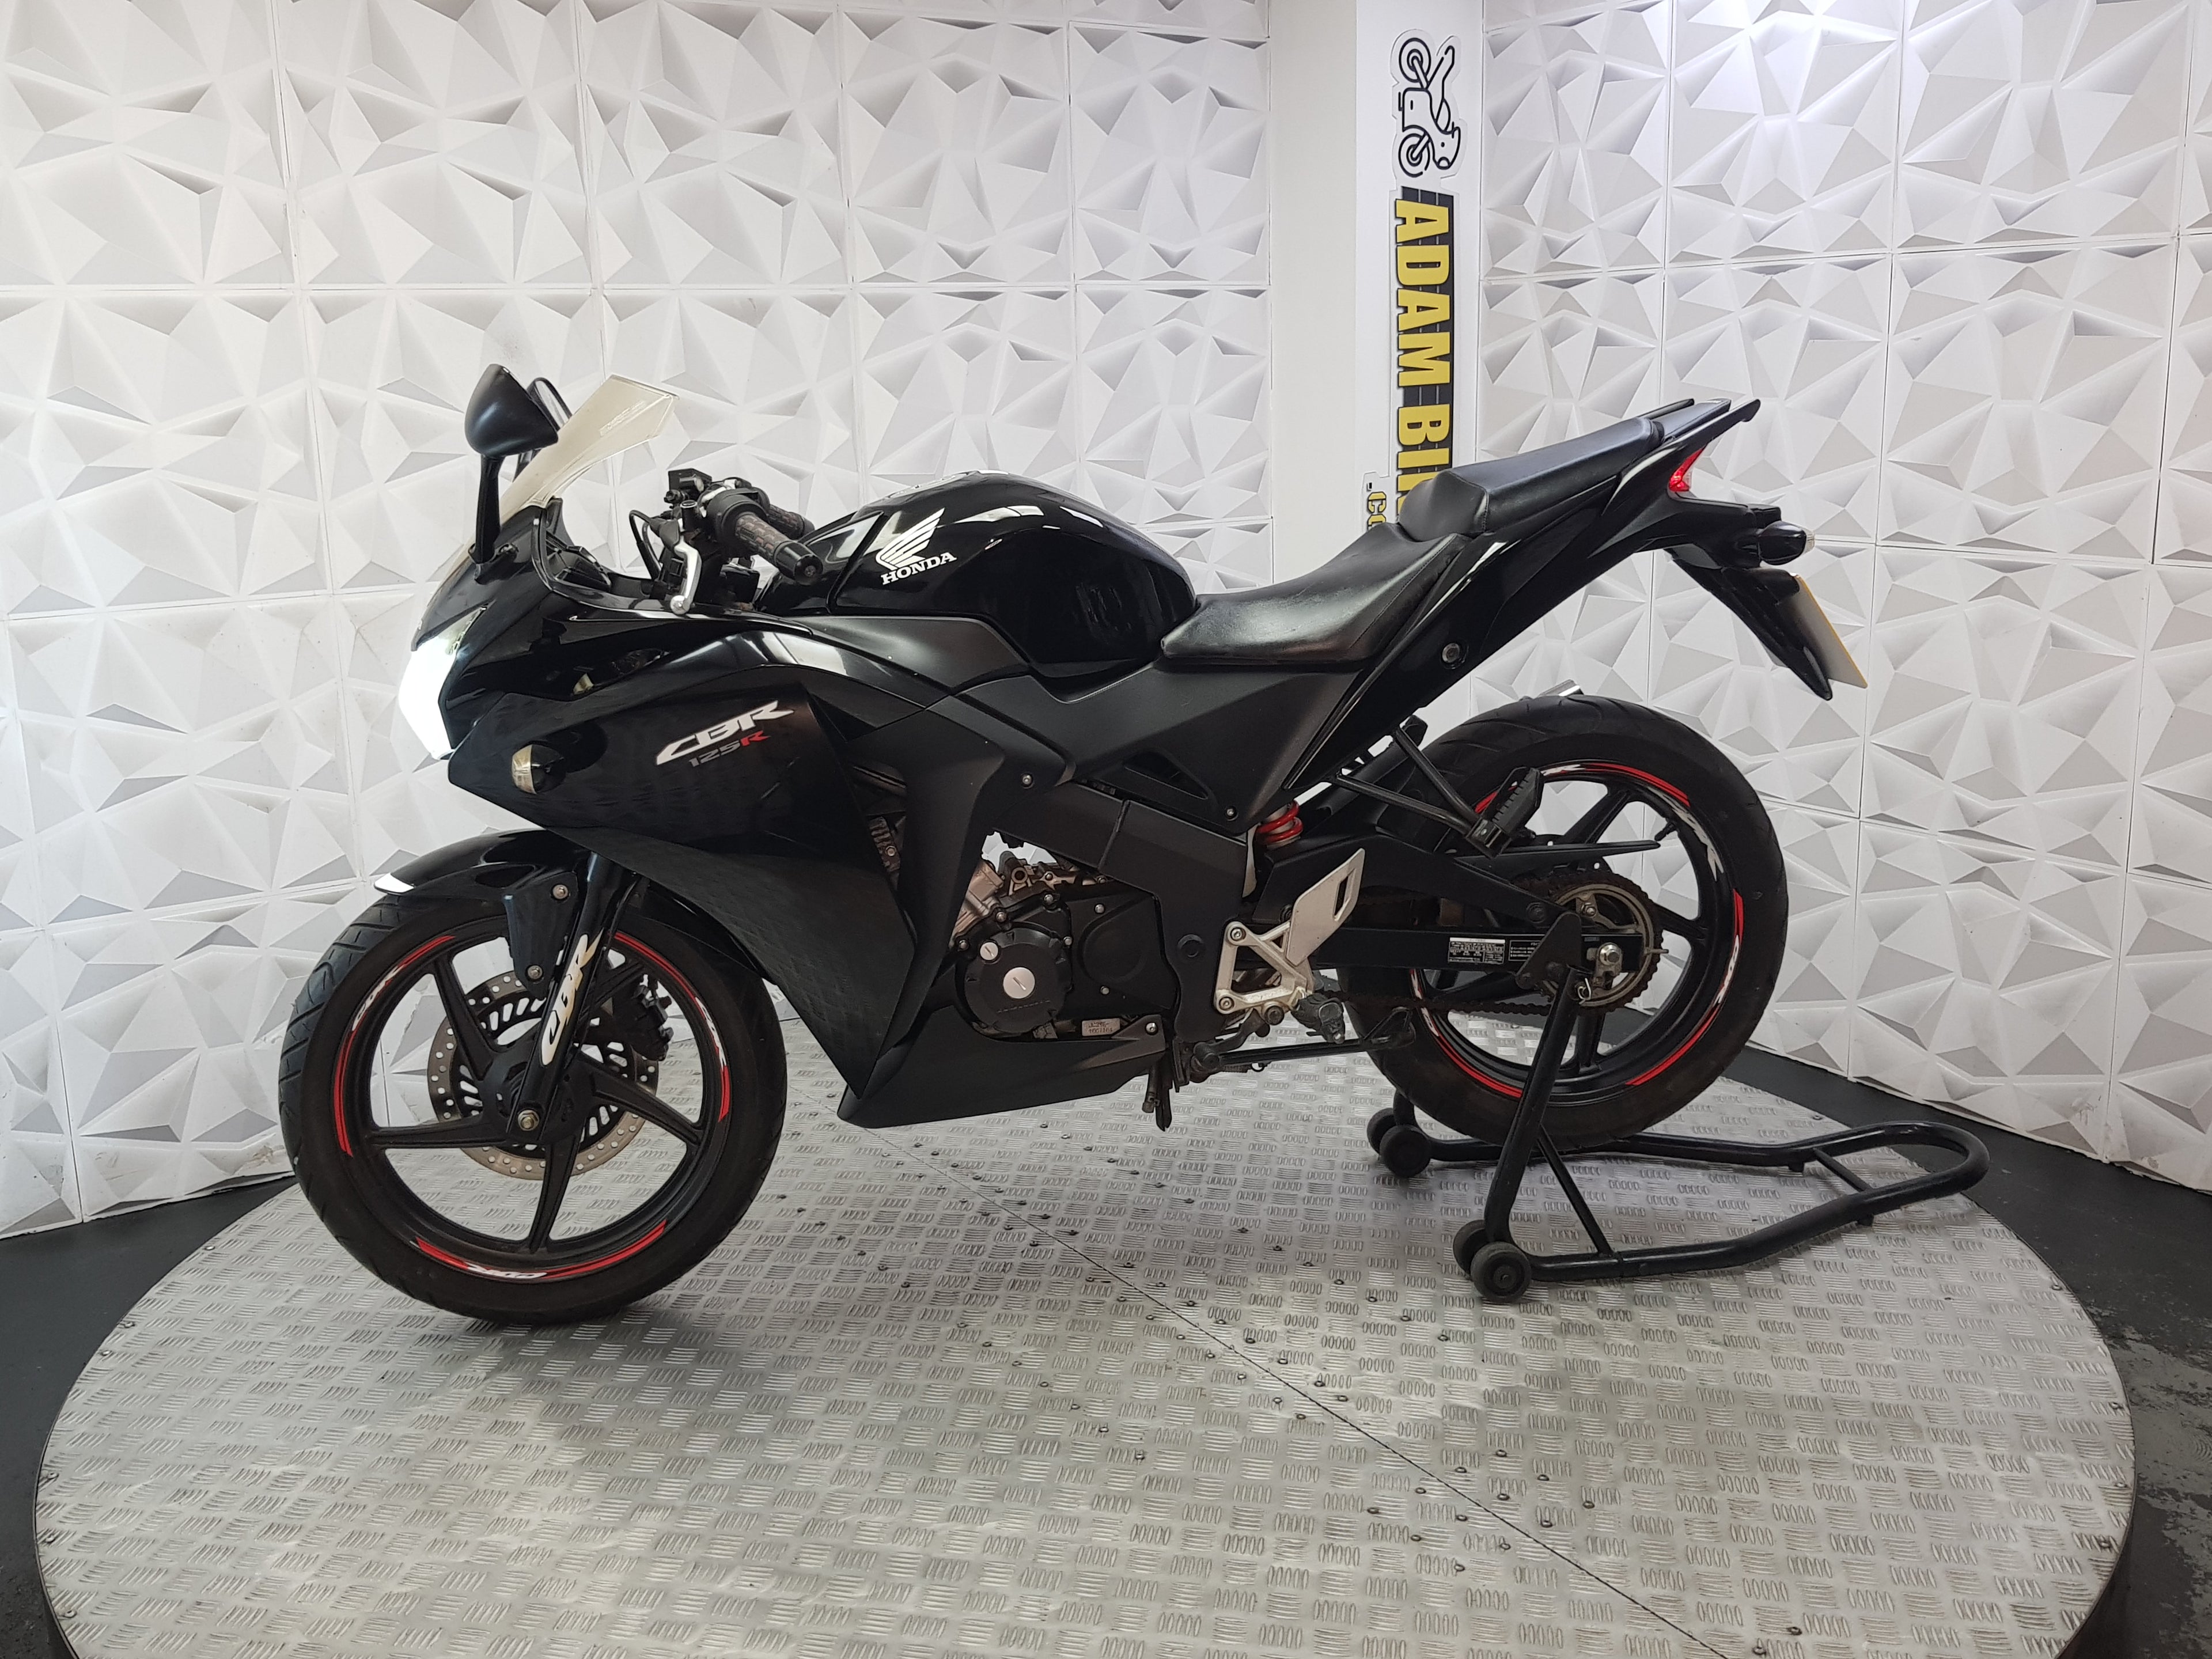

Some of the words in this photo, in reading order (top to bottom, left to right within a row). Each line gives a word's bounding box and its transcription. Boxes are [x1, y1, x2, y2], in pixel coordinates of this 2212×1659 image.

[1395, 198, 1450, 387] ADAM
[880, 551, 957, 585] HONDA
[656, 699, 794, 766] CBR
[689, 730, 771, 767] 125R
[540, 927, 604, 1066] CBR
